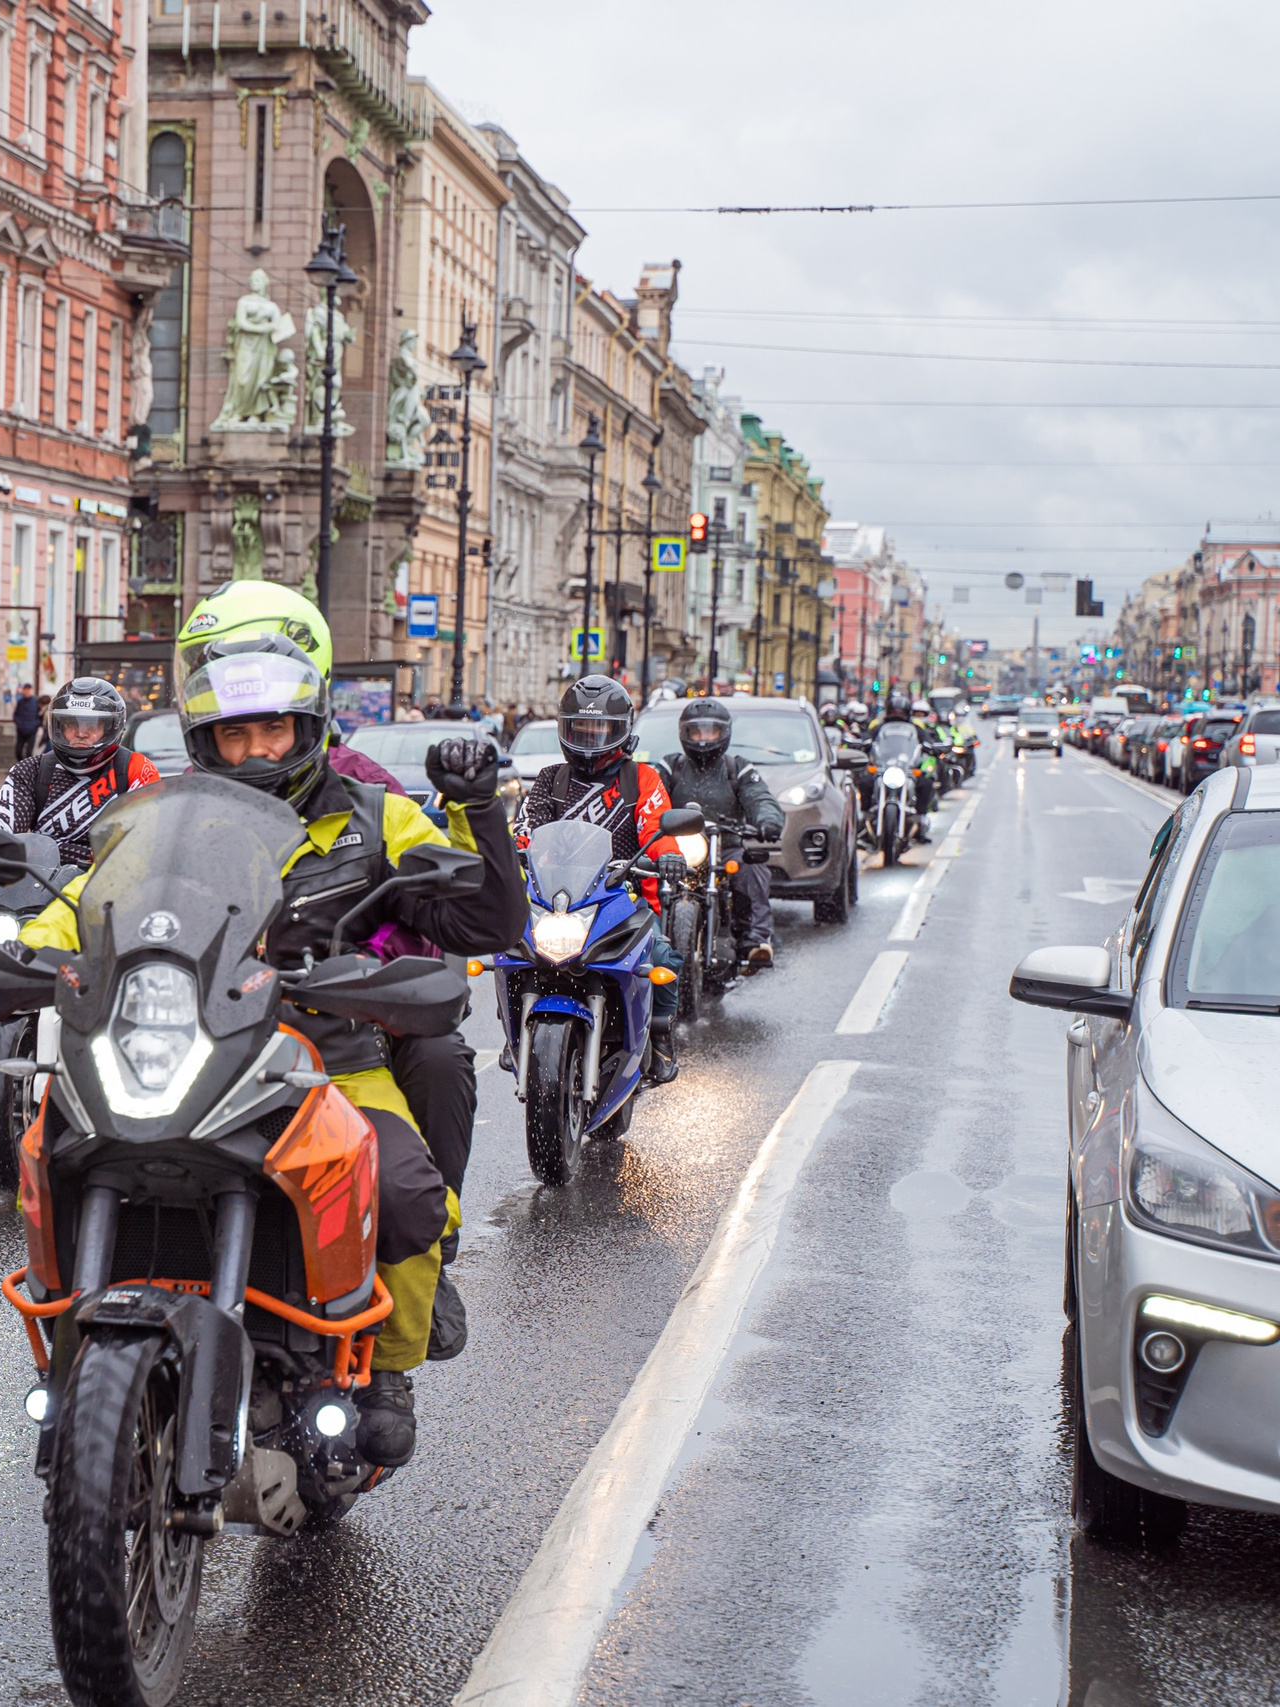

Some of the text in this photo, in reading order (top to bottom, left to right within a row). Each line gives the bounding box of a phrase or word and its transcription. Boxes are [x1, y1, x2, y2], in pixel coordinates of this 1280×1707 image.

[223, 680, 266, 699] SHOEI
[70, 700, 91, 709] SHOEI
[578, 708, 603, 716] SHARK
